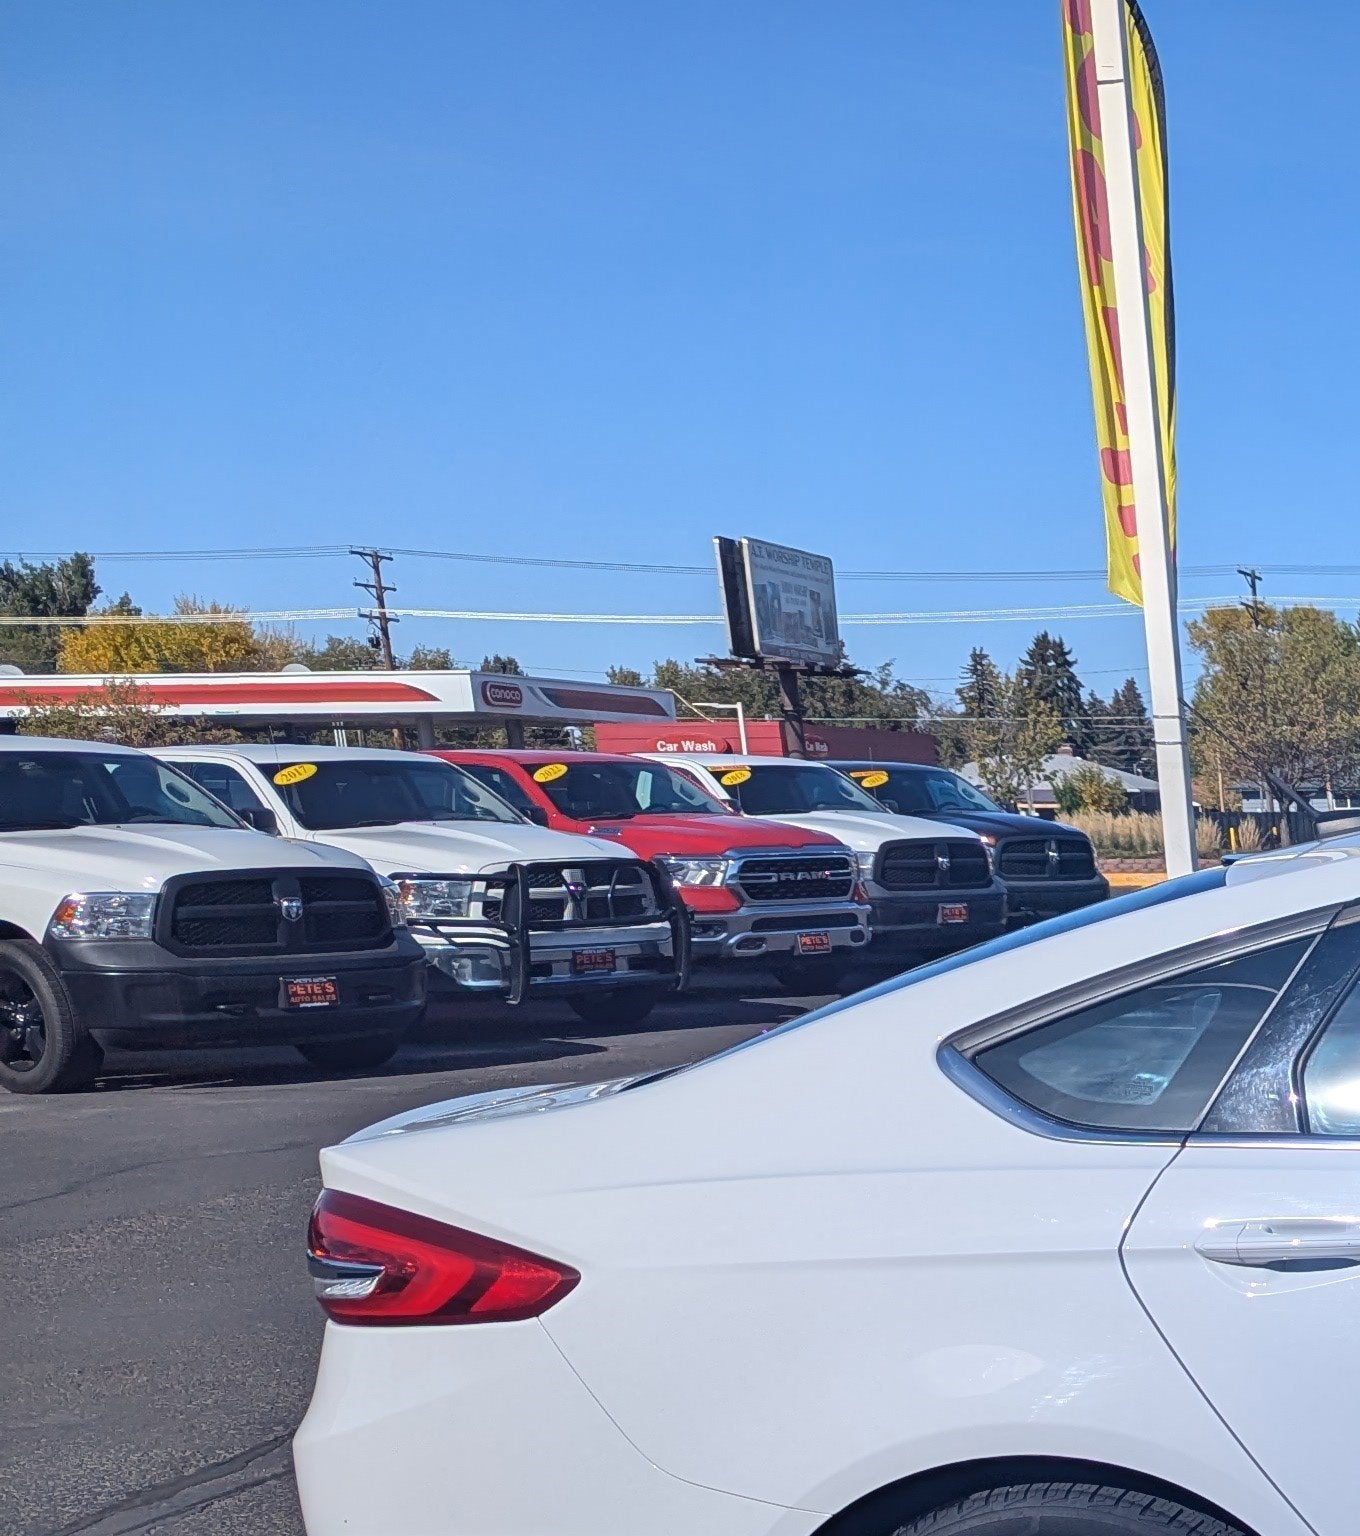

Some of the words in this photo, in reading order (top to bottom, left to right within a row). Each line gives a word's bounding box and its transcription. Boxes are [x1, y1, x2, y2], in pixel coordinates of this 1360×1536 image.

[656, 740, 679, 752] Car
[682, 740, 716, 752] Wash
[280, 765, 307, 783] 2017
[780, 869, 831, 881] RAM
[576, 952, 613, 964] PETE'S
[288, 981, 335, 994] PETE'S
